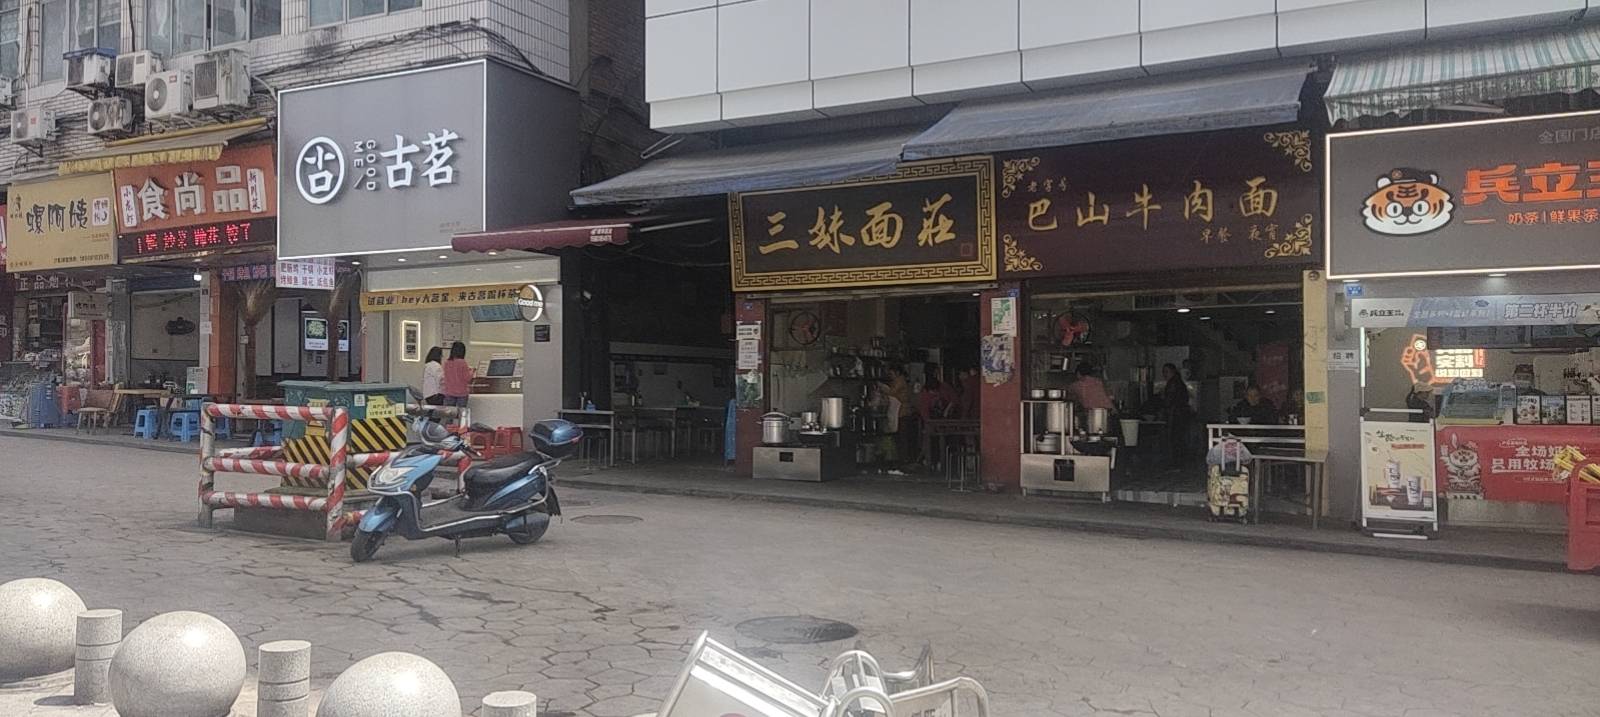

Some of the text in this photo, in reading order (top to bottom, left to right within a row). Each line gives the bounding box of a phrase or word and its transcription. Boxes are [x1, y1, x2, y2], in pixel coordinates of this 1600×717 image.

[365, 138, 377, 192] GOOD
[380, 128, 460, 189] 古茗
[137, 164, 249, 221] 食尚品
[1027, 176, 1278, 232] 巴山牛肉面
[1462, 160, 1600, 205] 兵立
[1200, 226, 1232, 244] 早餐
[1507, 208, 1600, 226] 奶茶 鲜果茶
[1503, 302, 1579, 319] 第二杯半价
[1332, 351, 1355, 362] 招聘
